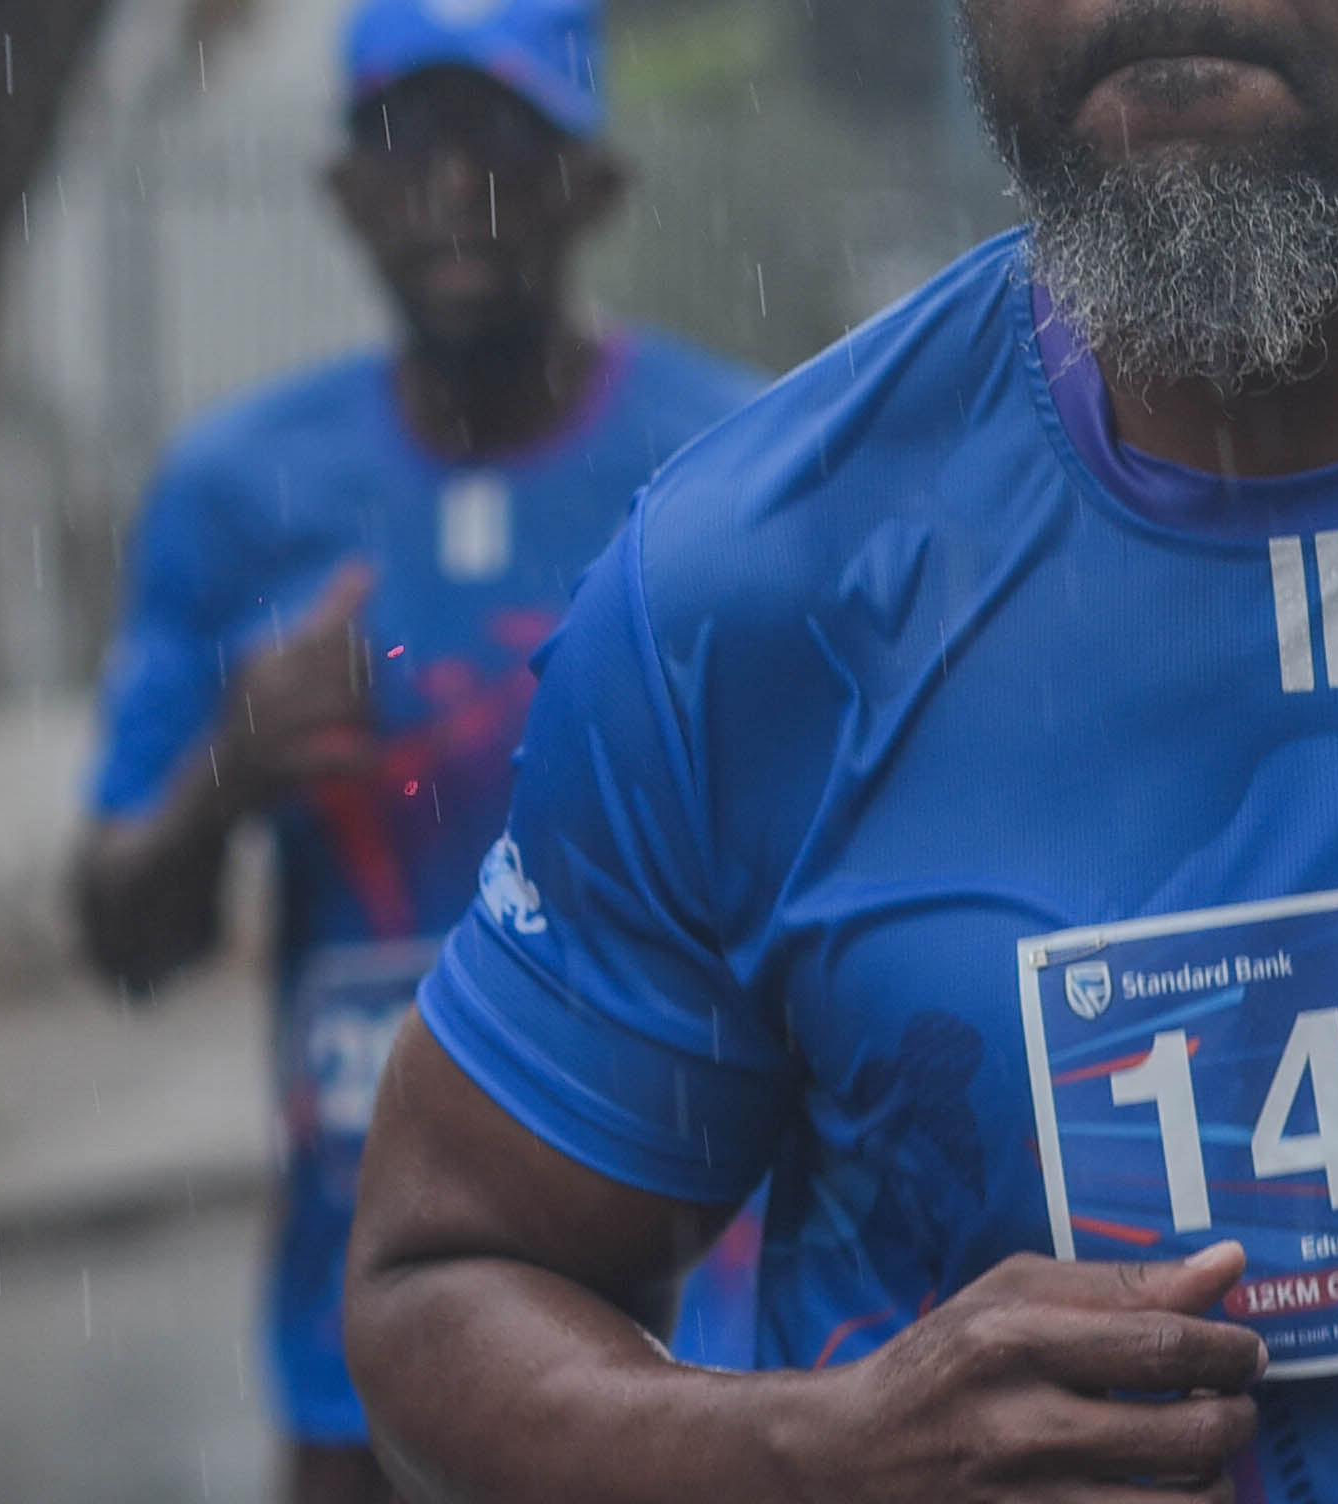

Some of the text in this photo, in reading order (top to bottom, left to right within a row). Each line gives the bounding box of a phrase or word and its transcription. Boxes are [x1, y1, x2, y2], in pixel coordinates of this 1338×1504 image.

[1122, 949, 1293, 1000] Standard Bank
[1246, 1278, 1320, 1312] 12KM
